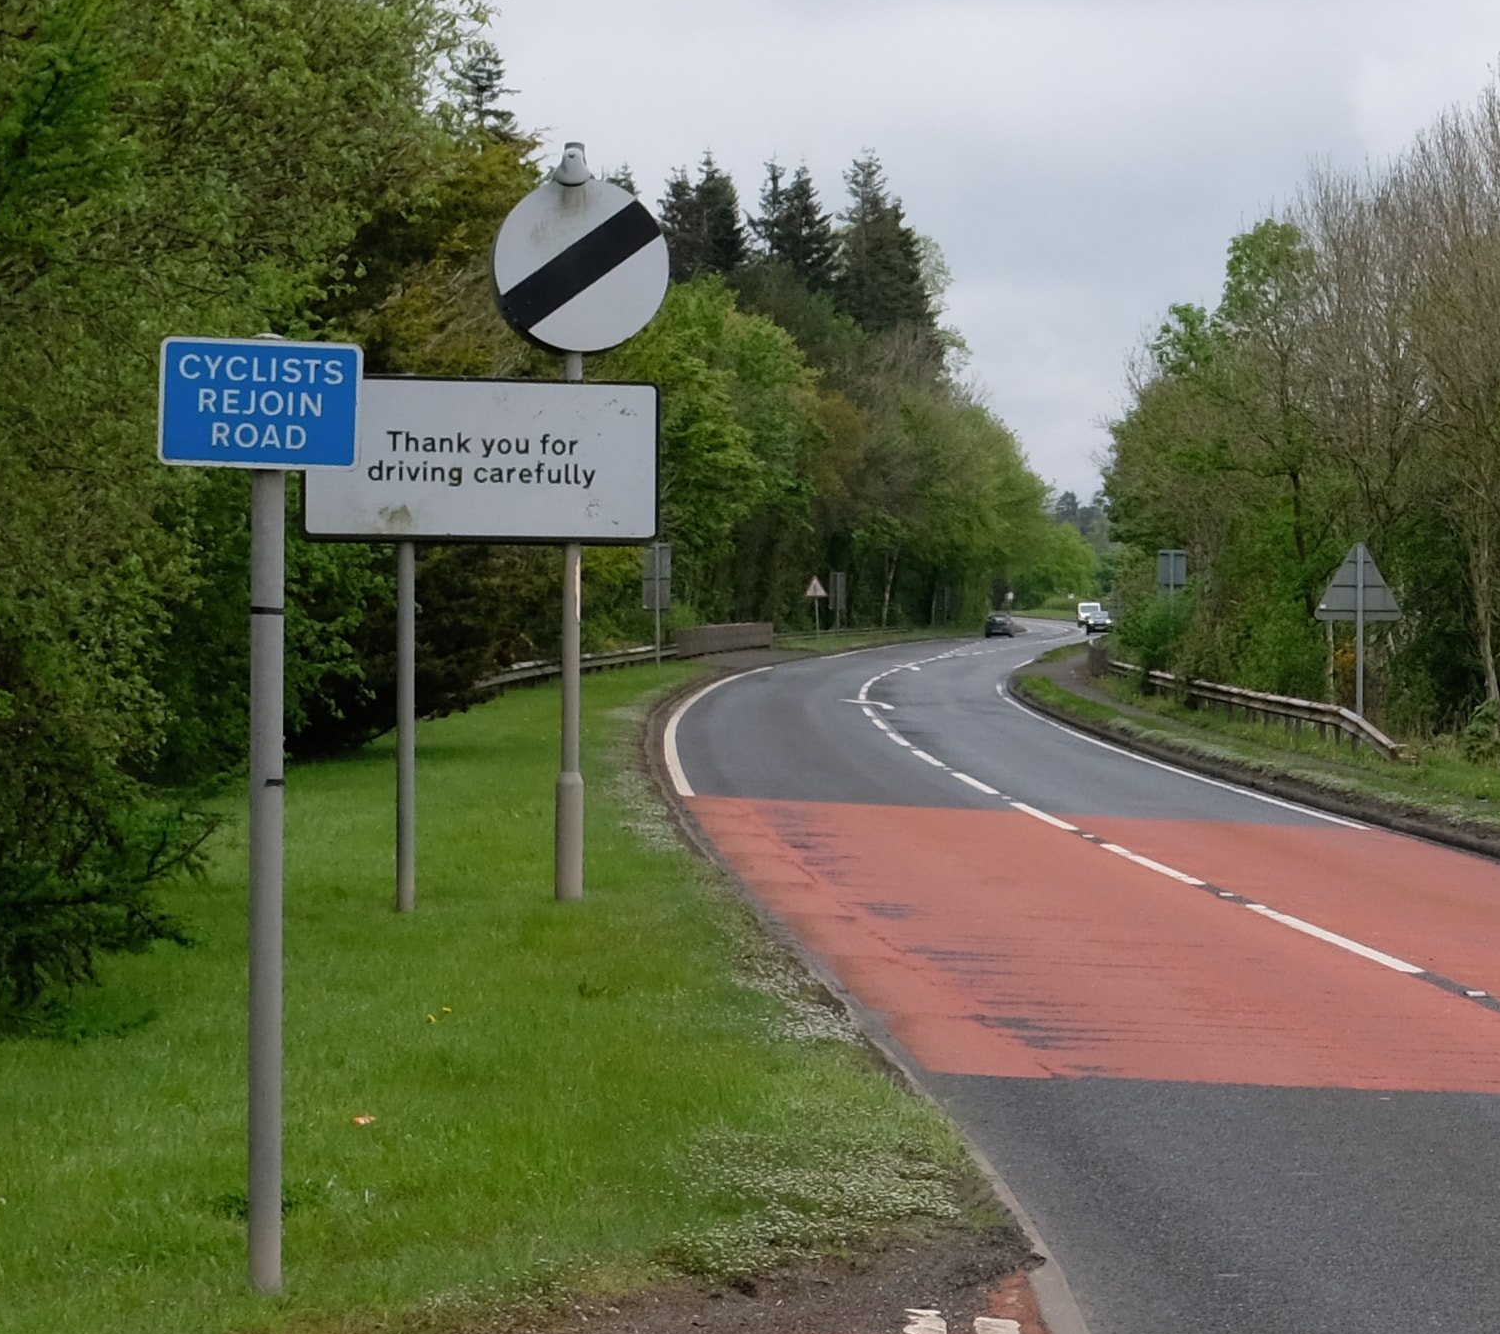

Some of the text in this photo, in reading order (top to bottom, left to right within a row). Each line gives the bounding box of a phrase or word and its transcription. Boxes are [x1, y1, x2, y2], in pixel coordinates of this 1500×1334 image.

[178, 353, 344, 386] CYCLISTS
[198, 388, 323, 417] REJOIN
[210, 422, 308, 451] ROAD
[386, 430, 580, 457] Thank you for
[366, 461, 596, 490] driving carefully
